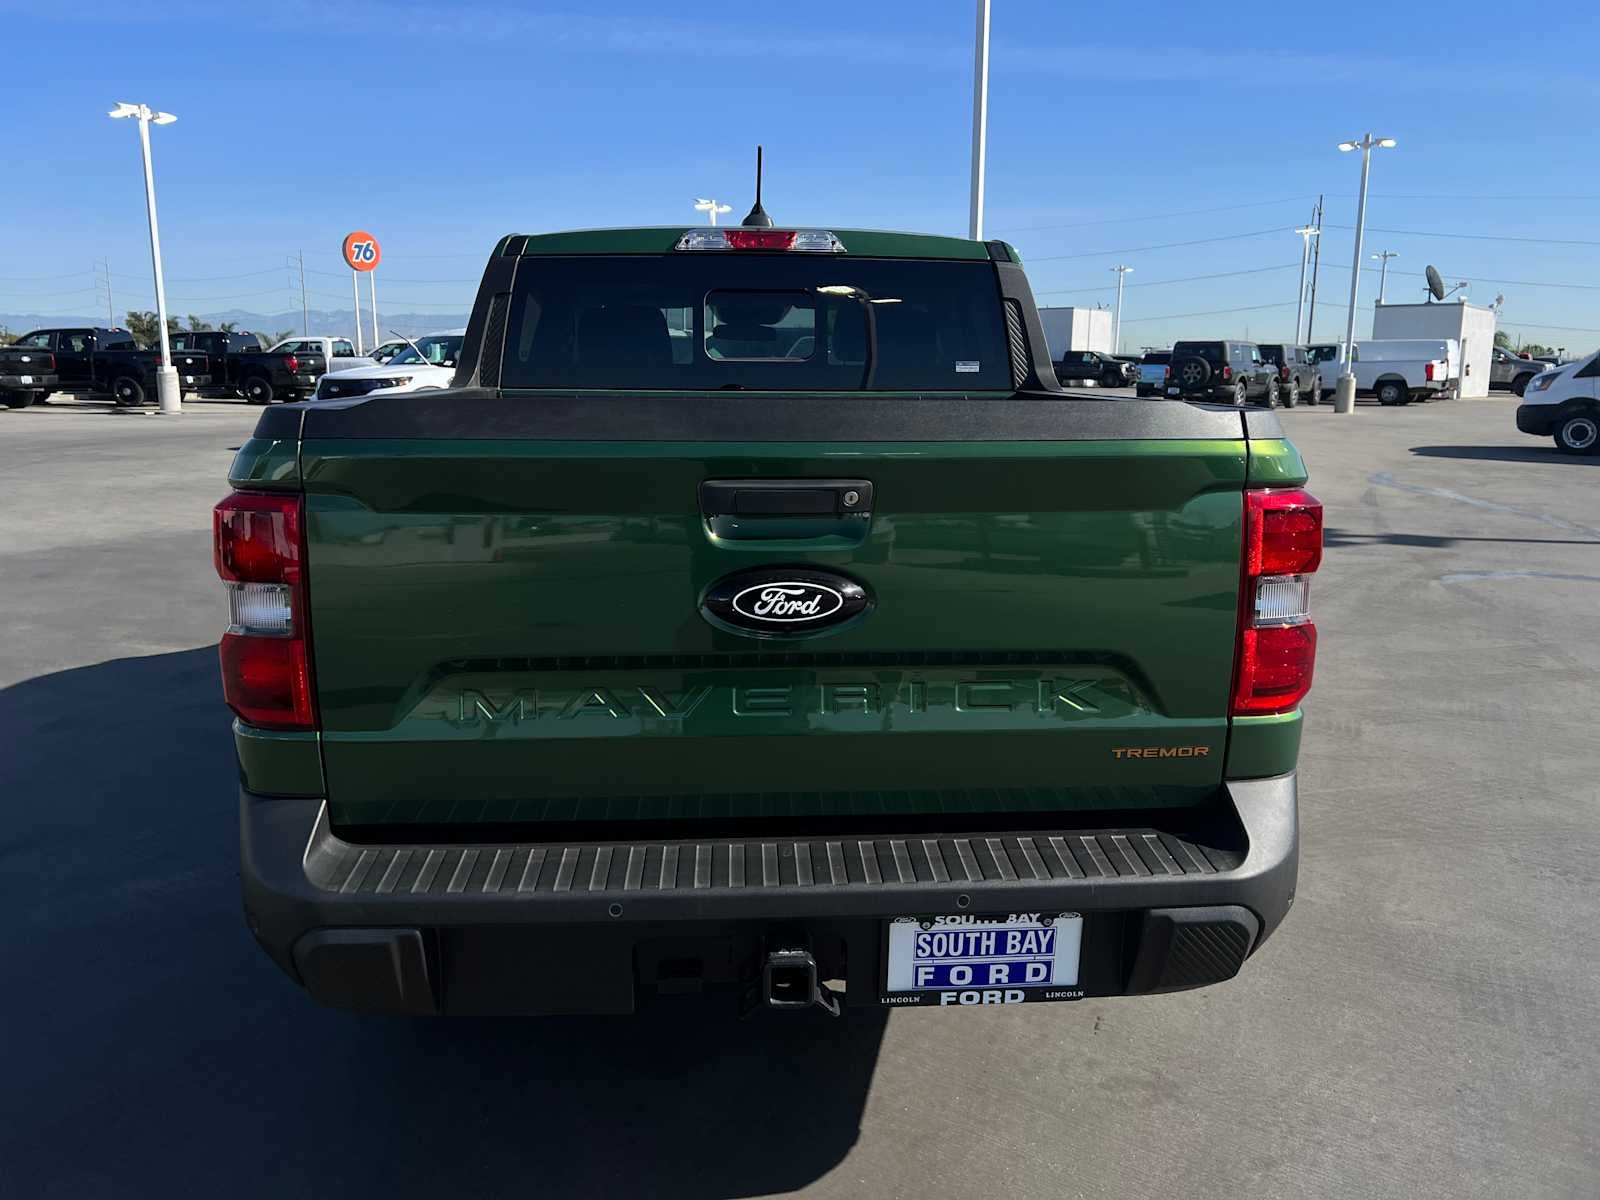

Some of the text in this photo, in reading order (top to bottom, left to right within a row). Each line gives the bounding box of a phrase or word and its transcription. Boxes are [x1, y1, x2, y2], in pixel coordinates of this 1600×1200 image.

[352, 240, 376, 263] 76
[753, 587, 822, 615] Ford
[458, 680, 1101, 722] MAVERICK
[1111, 746, 1209, 758] TREMOR
[1006, 913, 1040, 924] BAY
[917, 930, 1053, 957] SOUTH BAY
[918, 963, 1047, 986] FORD
[881, 996, 921, 1004] LINCOLN
[940, 990, 1025, 1005] FORD
[1045, 991, 1084, 999] LINCOLN
